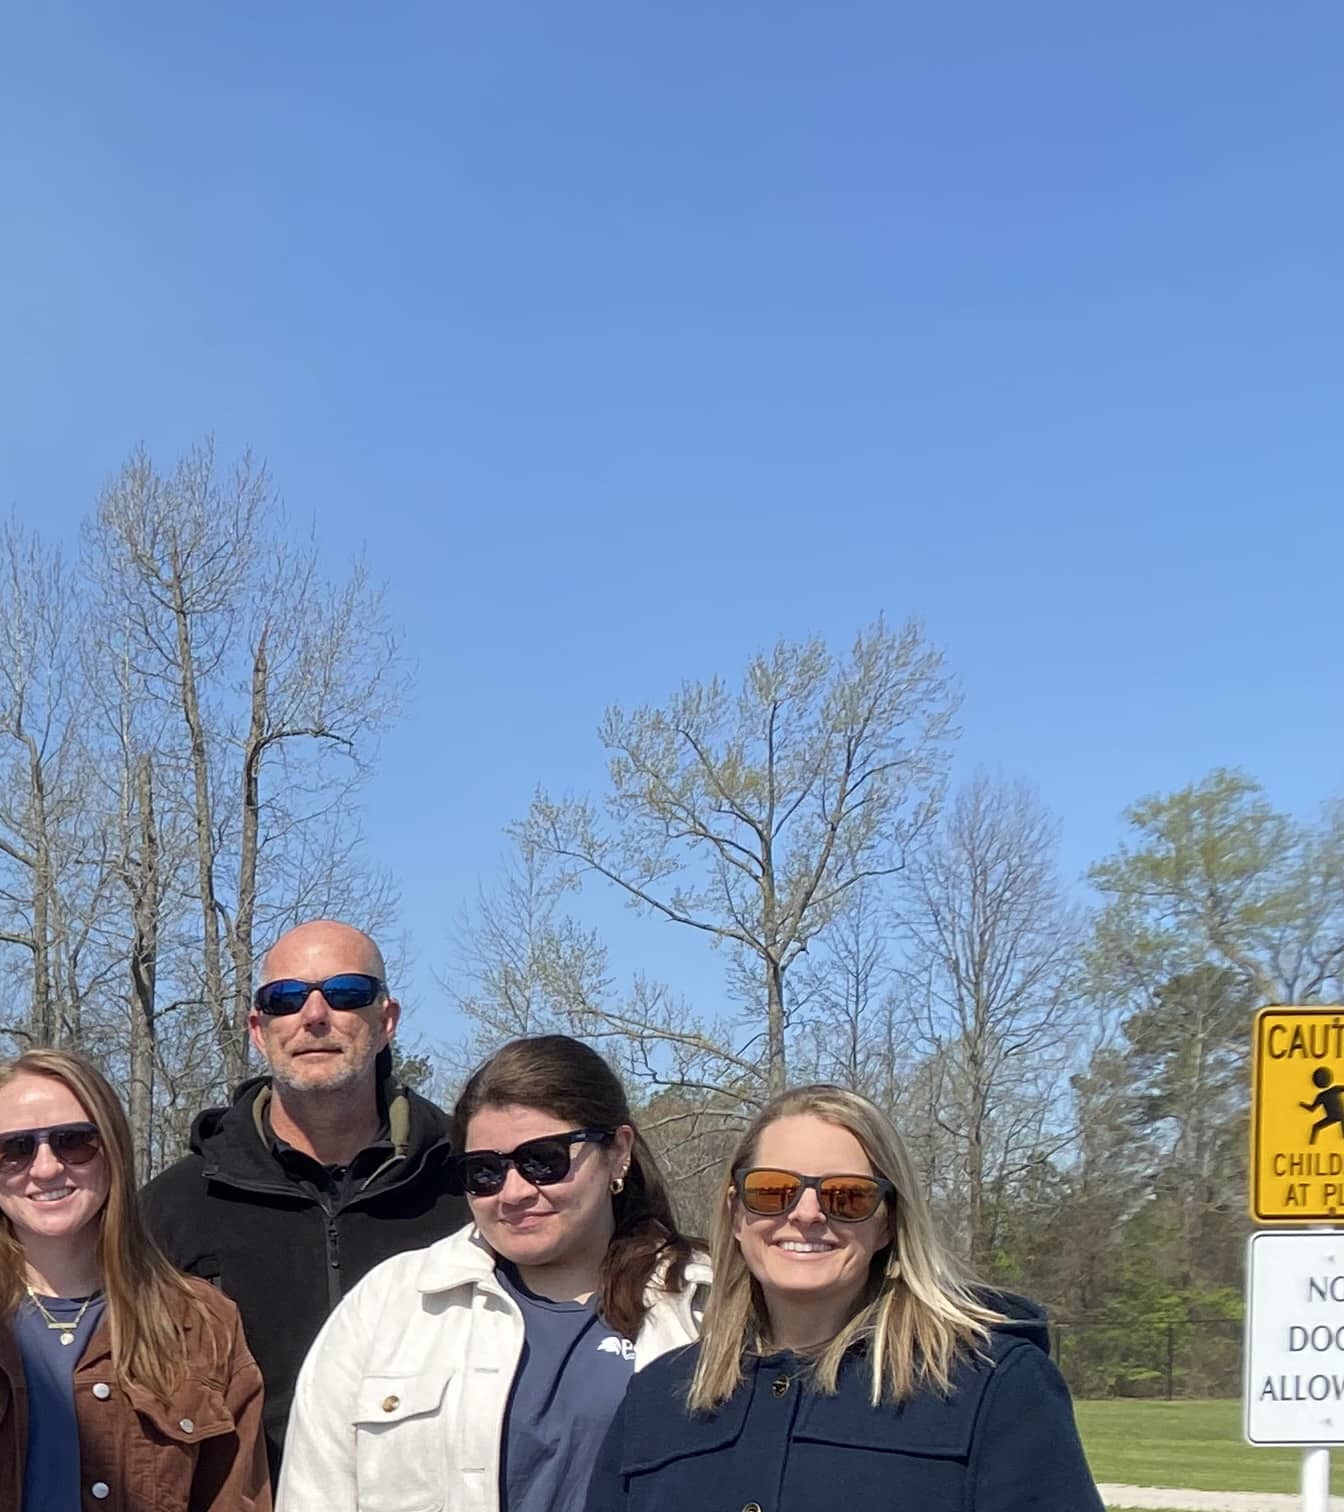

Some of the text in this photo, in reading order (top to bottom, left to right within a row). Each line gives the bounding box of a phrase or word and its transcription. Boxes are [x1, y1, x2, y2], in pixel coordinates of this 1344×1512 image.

[1267, 1022, 1344, 1060] CAUT
[1273, 1152, 1344, 1177] CHILD
[1284, 1183, 1311, 1207] AT
